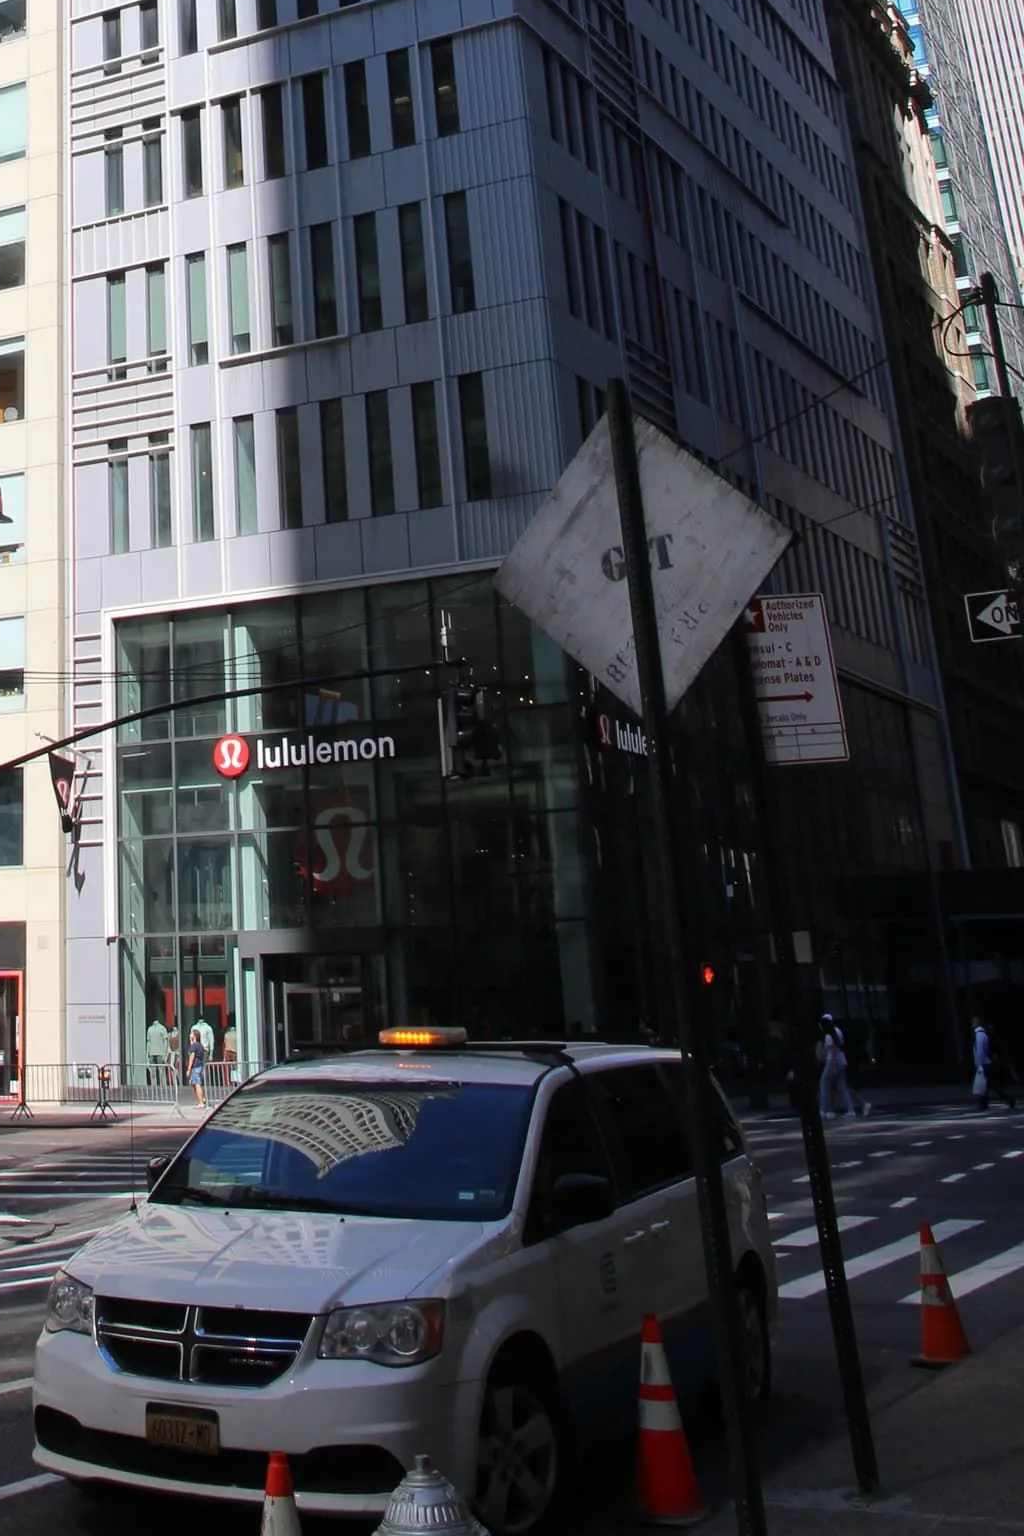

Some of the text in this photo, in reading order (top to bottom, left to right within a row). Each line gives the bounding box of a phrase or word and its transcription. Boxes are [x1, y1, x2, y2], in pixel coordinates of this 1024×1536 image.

[601, 534, 674, 582] GT
[765, 600, 814, 610] Authorized
[767, 612, 804, 622] Vehicles
[991, 604, 1019, 624] ON
[768, 623, 788, 633] Only
[785, 642, 793, 652] C
[795, 657, 802, 667] A
[814, 654, 821, 666] D
[784, 672, 815, 683] Plates
[257, 735, 395, 769] lululemon
